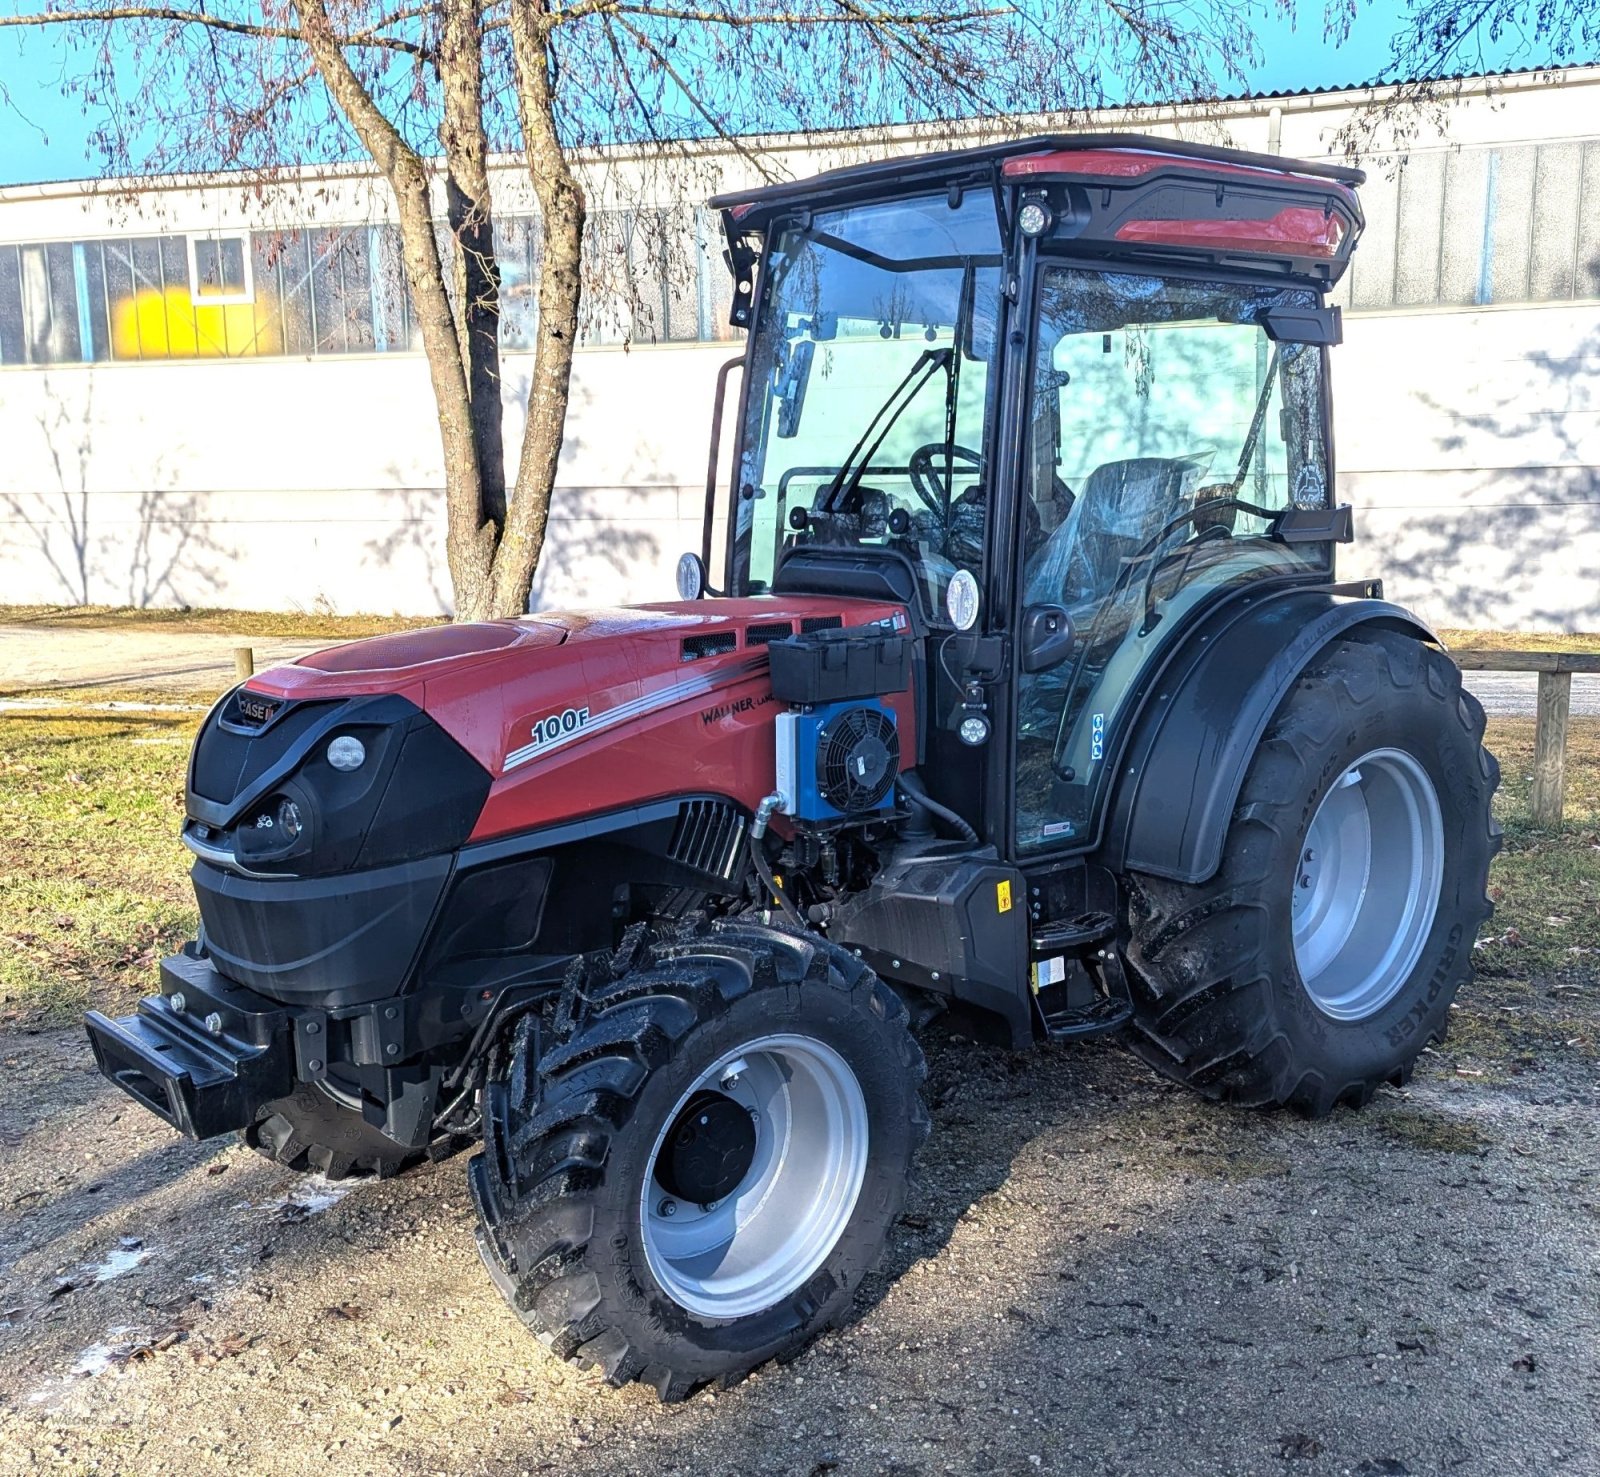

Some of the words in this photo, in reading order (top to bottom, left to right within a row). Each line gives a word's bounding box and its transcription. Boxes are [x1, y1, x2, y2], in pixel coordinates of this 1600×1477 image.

[240, 701, 265, 719] CASE
[701, 698, 755, 726] WALLNER
[532, 707, 589, 744] 100F
